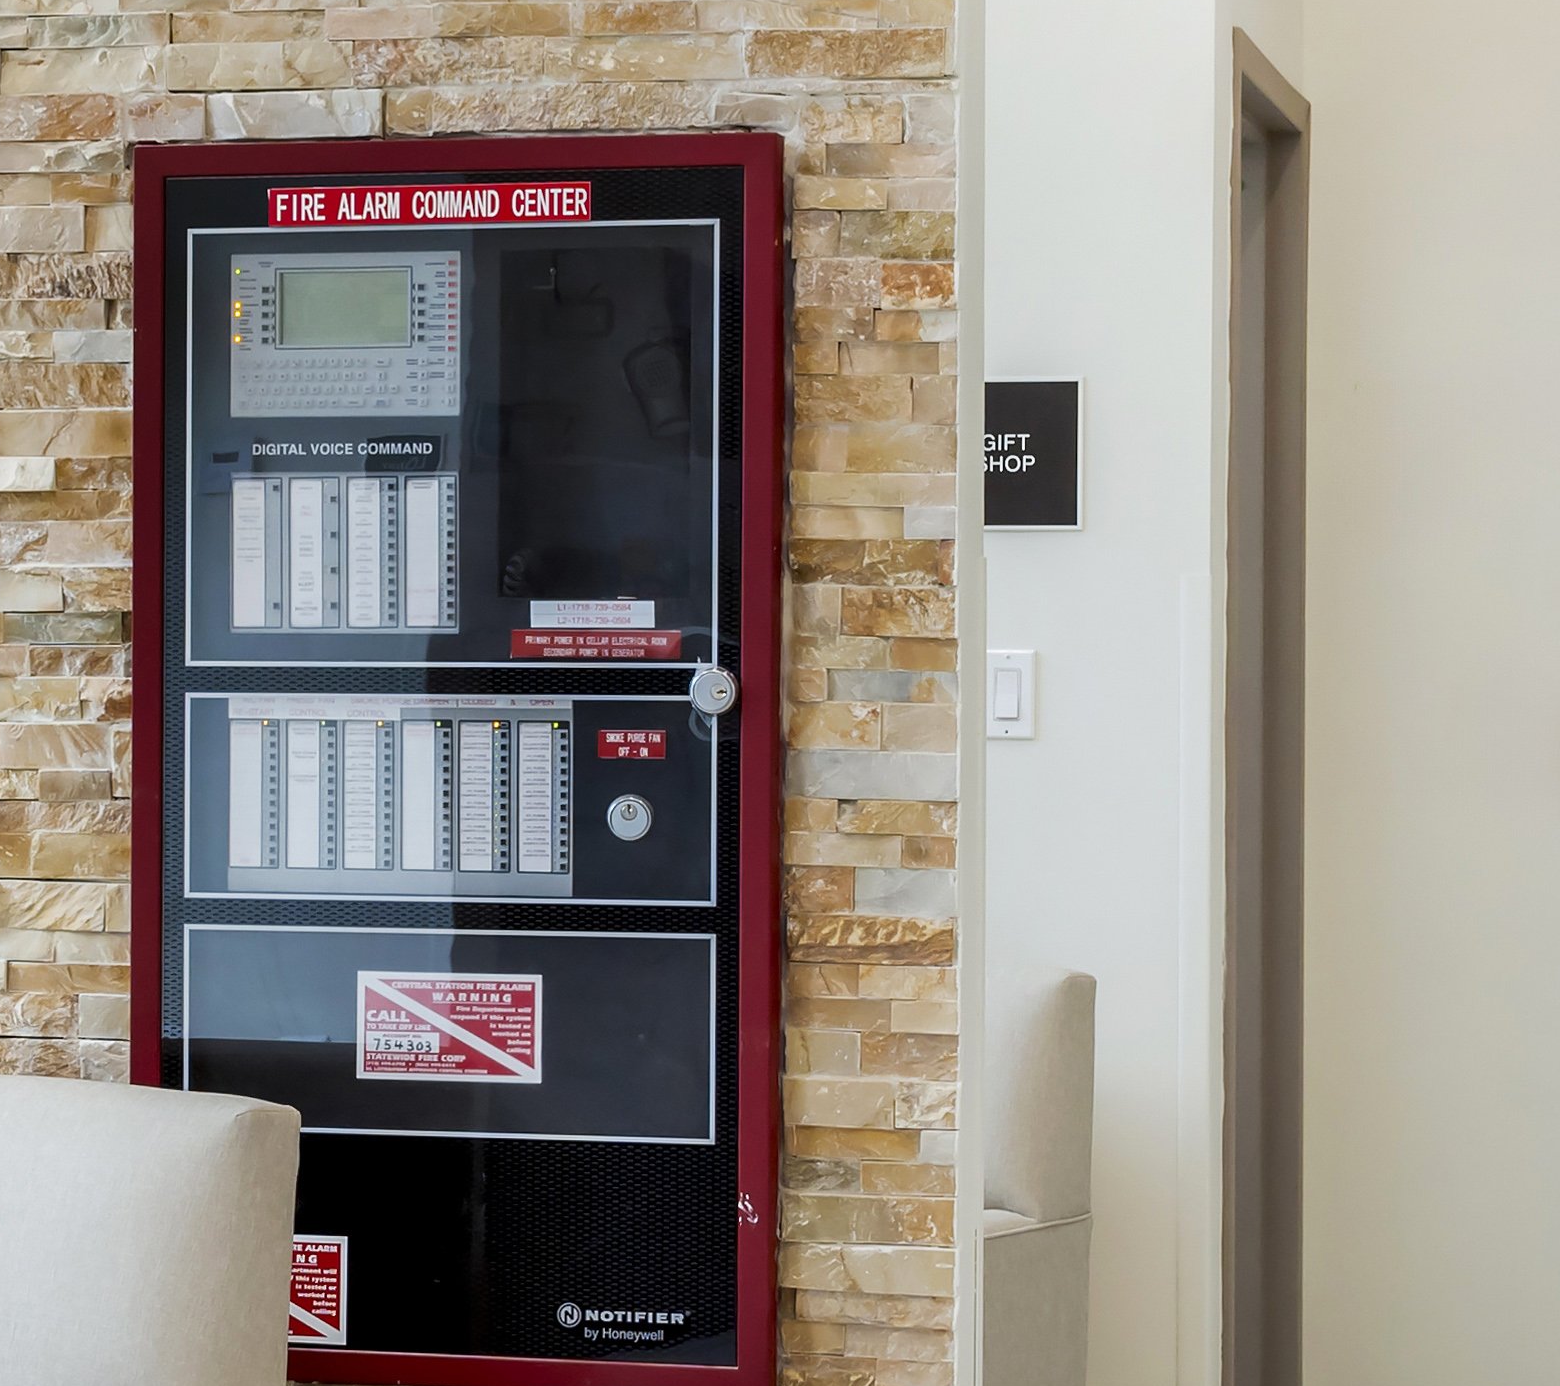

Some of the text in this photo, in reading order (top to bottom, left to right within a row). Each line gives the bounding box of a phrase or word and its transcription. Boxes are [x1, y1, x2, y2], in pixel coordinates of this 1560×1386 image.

[276, 188, 588, 222] FIRE ALARM COMMAND CENTER
[983, 433, 1031, 451] GIFT
[252, 442, 434, 456] DIGITAL VOICE COMMAND
[525, 636, 668, 646] PRIMARY POWER IN CELLAR ELECTRICAL ROOM
[543, 648, 645, 658] SECONDARY POWER IN GENERATOR
[606, 733, 661, 743] SMOKE PURGE FAN
[618, 746, 630, 757] OFF
[639, 747, 648, 757] ON
[391, 982, 532, 991] CENTRAL STATION FIRE ALARM
[432, 992, 513, 1003] WARNING
[472, 1006, 516, 1014] Department
[366, 1009, 410, 1023] CALL
[366, 1023, 432, 1031] TO TAKE OFF LINE
[366, 1053, 466, 1063] STATEWIDE FIRE CORP
[304, 1244, 338, 1253] ALARM
[311, 1276, 337, 1284] system
[303, 1283, 327, 1291] tested
[297, 1291, 326, 1299] worked
[311, 1308, 337, 1316] calling
[584, 1309, 685, 1325] NOTIFIER
[584, 1326, 665, 1343] by Honeywell
